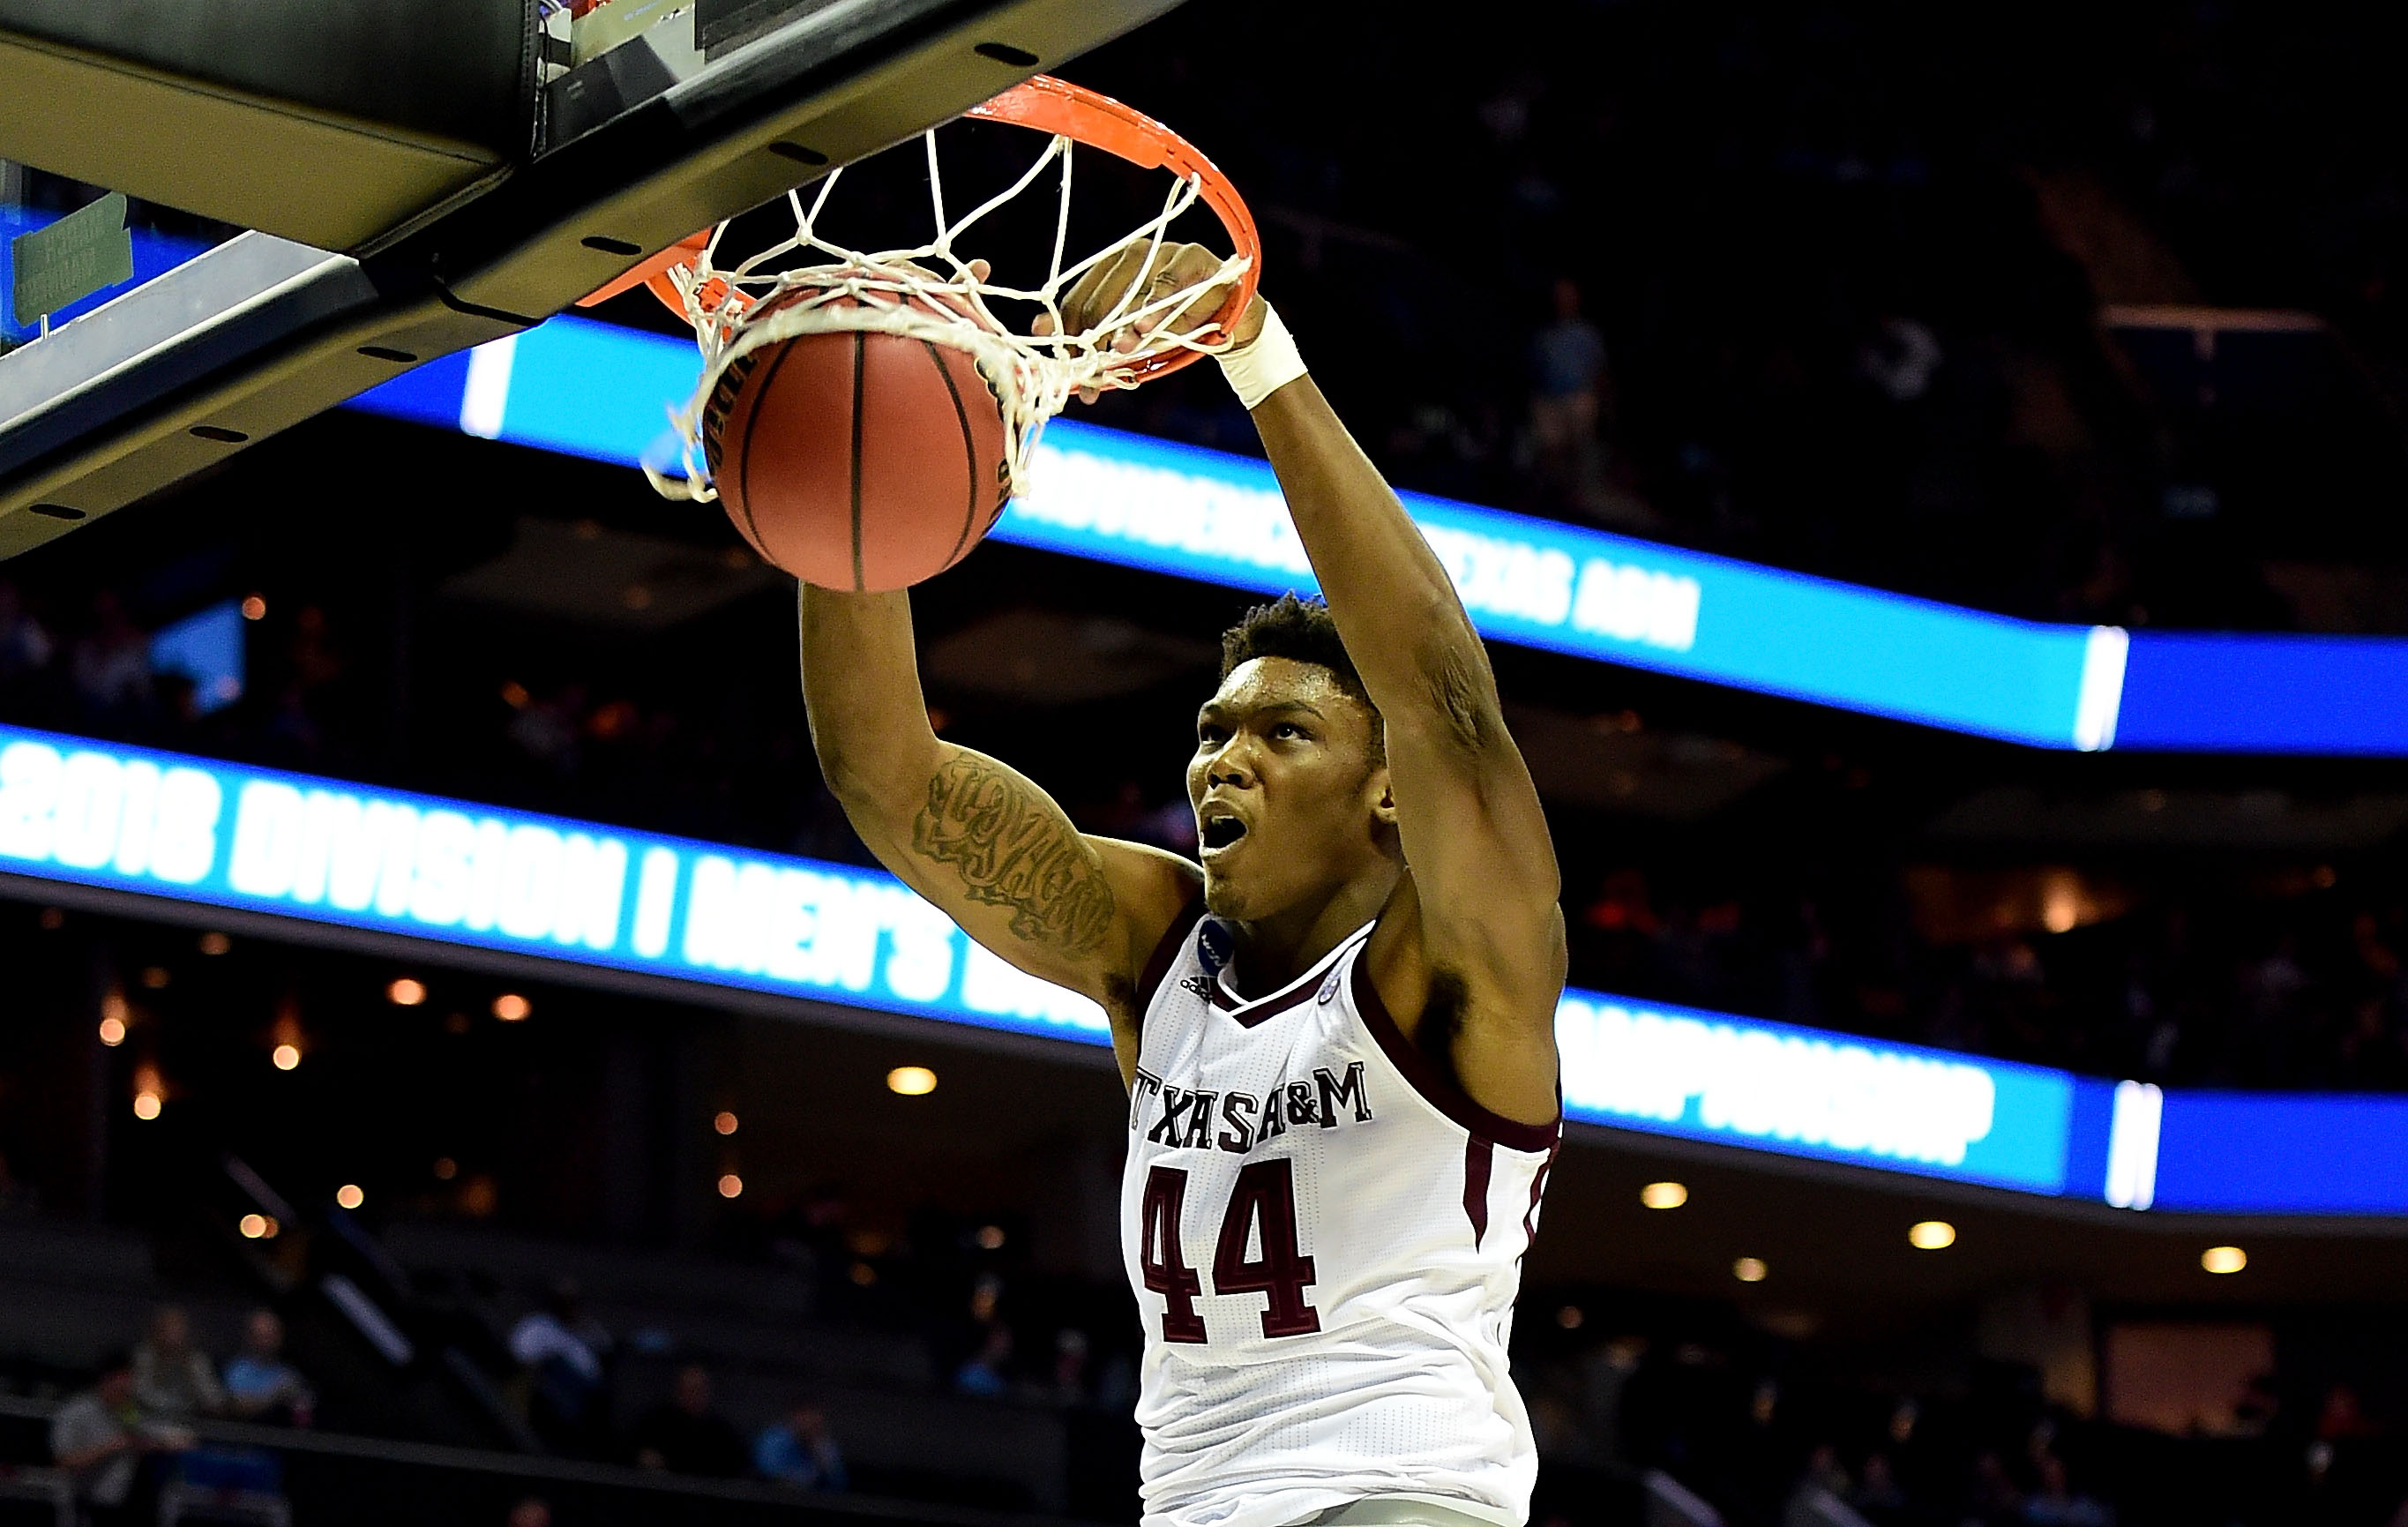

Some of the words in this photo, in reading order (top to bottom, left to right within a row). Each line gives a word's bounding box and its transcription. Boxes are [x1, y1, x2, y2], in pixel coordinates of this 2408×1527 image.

[1008, 444, 1316, 573] ROVIDENC
[228, 780, 629, 950] DIVISION
[632, 845, 678, 959] I
[683, 854, 960, 1002] MEN'S
[1129, 1065, 1260, 1154] TXAS
[1140, 1156, 1321, 1344] 44
